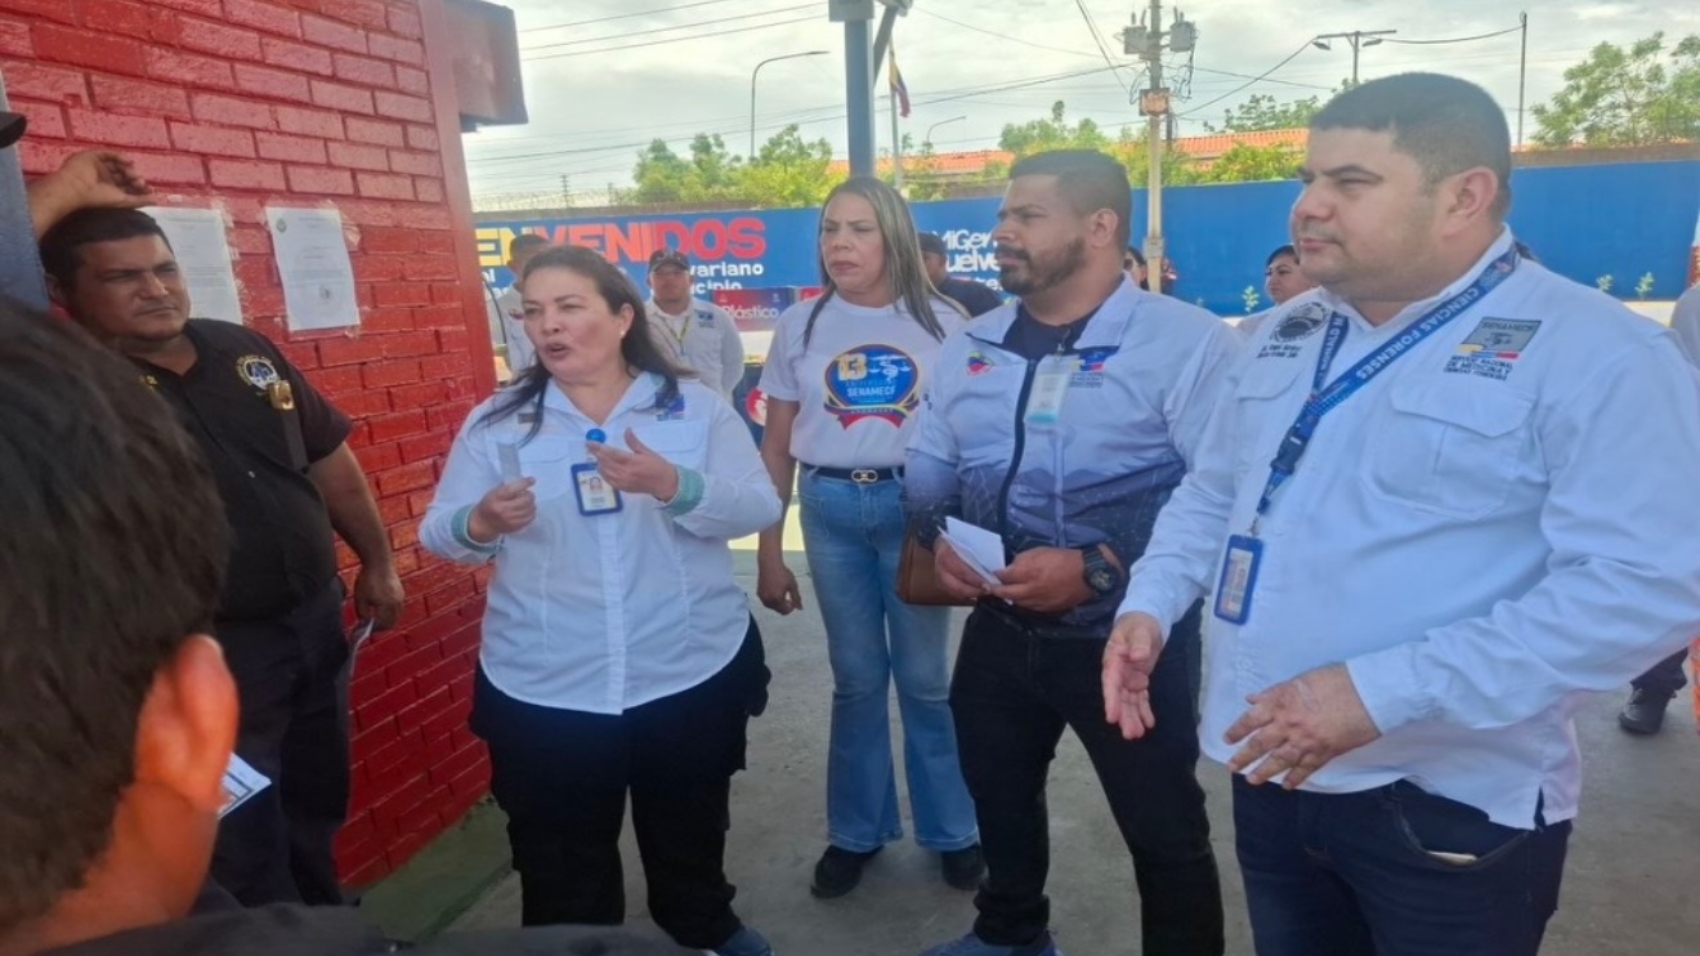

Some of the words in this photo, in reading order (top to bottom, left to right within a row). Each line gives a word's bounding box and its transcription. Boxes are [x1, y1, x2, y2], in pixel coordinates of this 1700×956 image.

[1420, 287, 1480, 332] CIENCIAS
[836, 353, 868, 381] 13
[1356, 329, 1421, 380] FORENSES
[845, 385, 896, 398] SENAMECF
